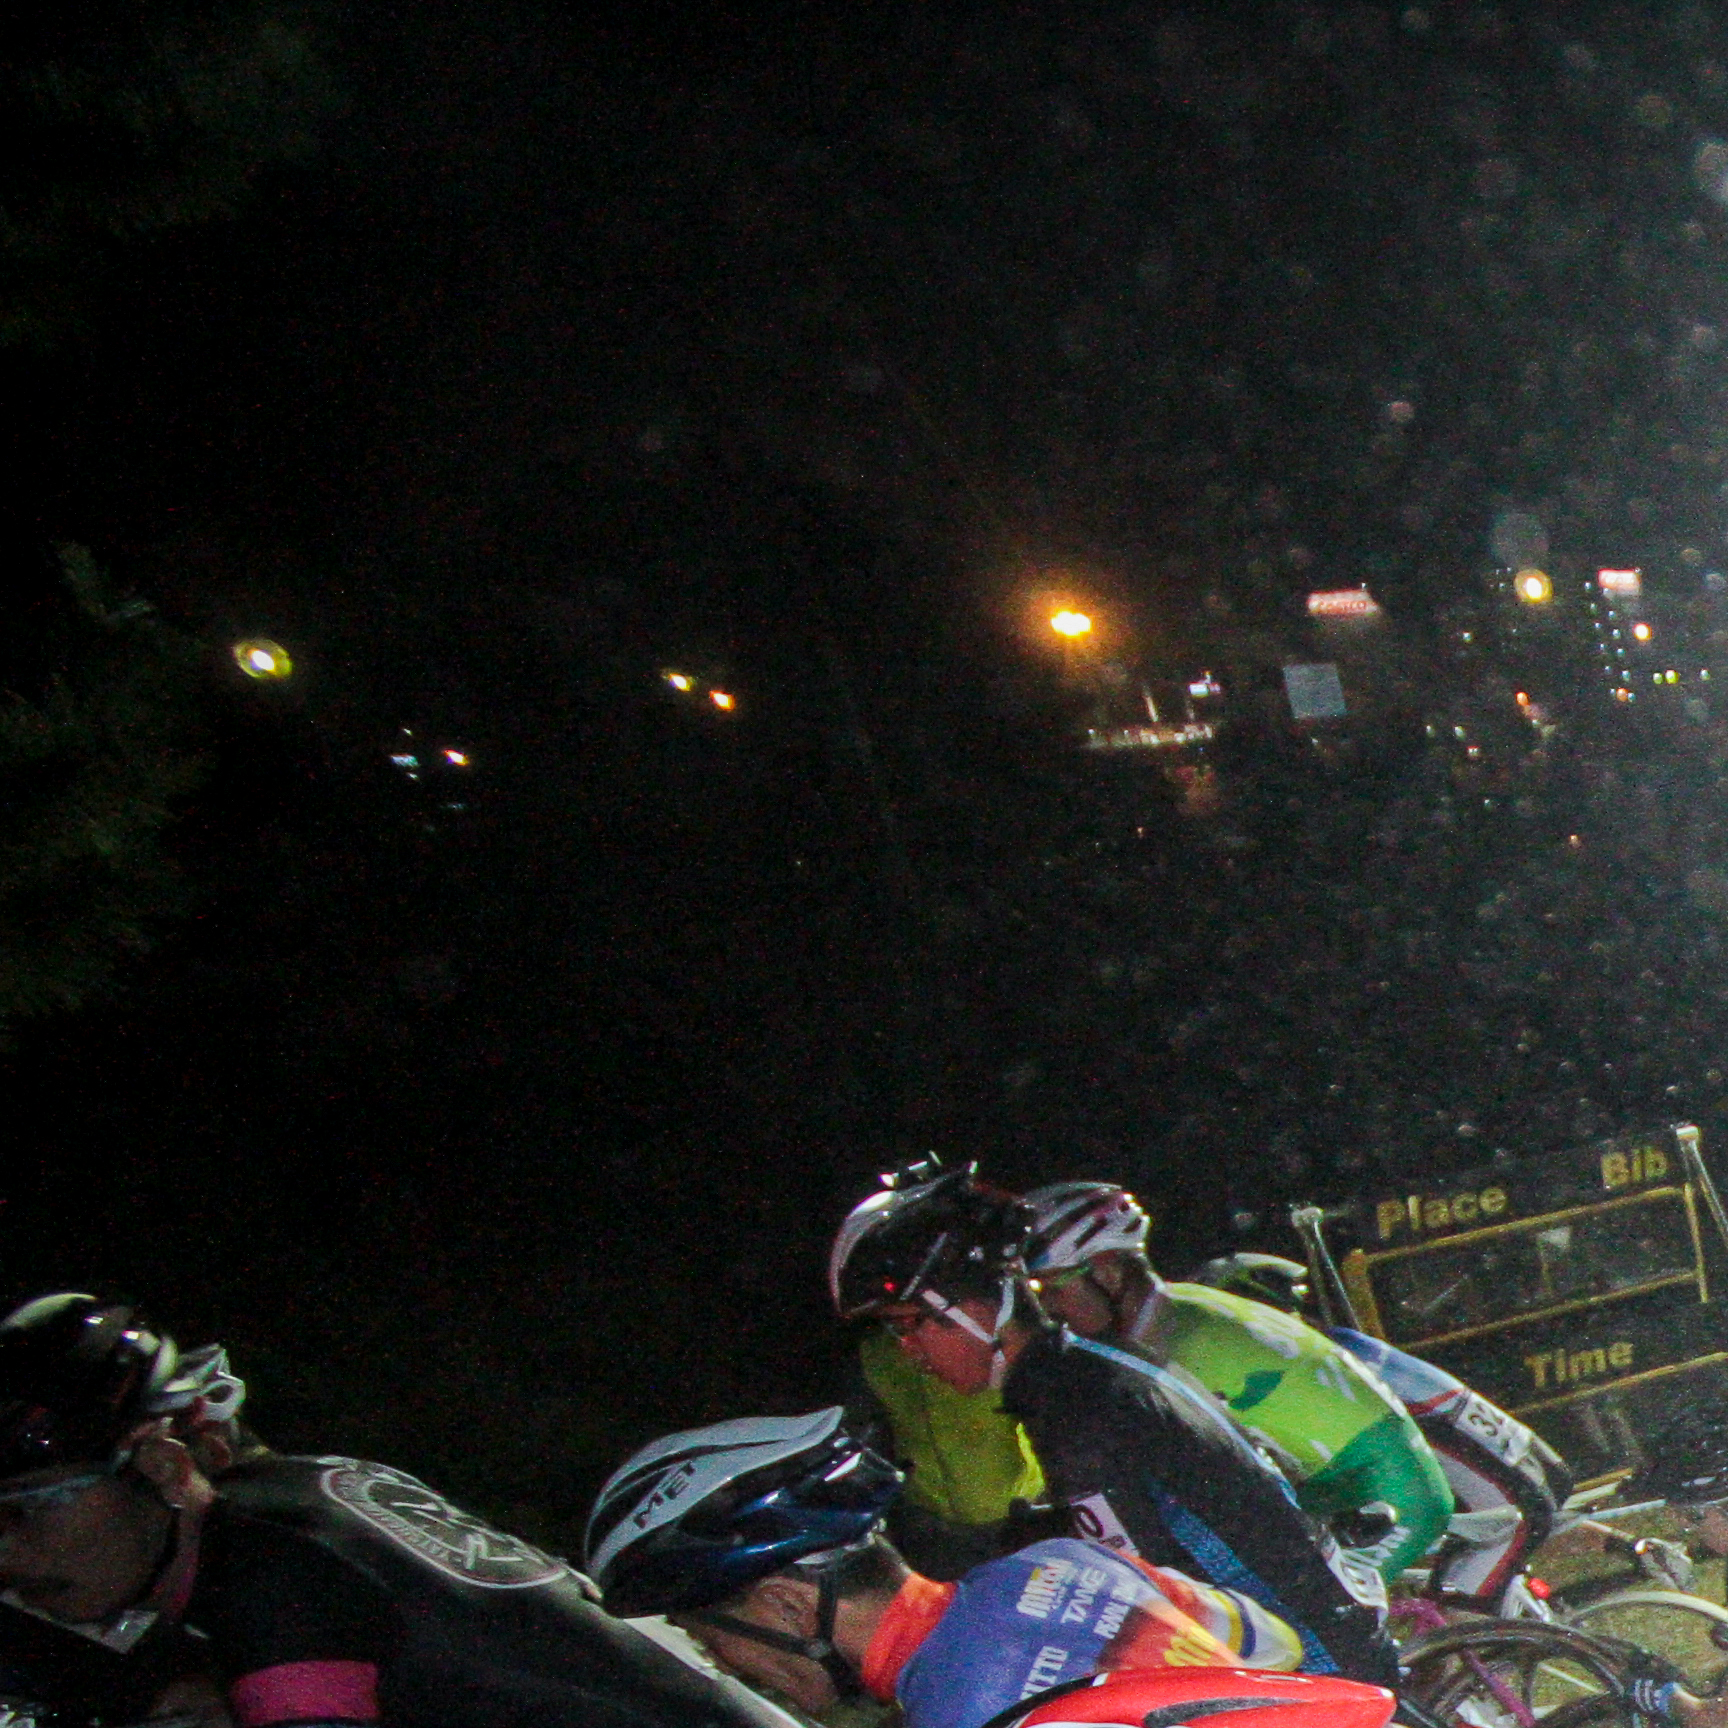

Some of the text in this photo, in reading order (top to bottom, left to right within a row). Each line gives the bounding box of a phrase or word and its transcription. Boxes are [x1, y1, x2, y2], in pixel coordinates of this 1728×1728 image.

[1376, 1147, 1669, 1240] Place Bib
[1524, 1341, 1634, 1388] Time
[632, 1460, 696, 1529] MET
